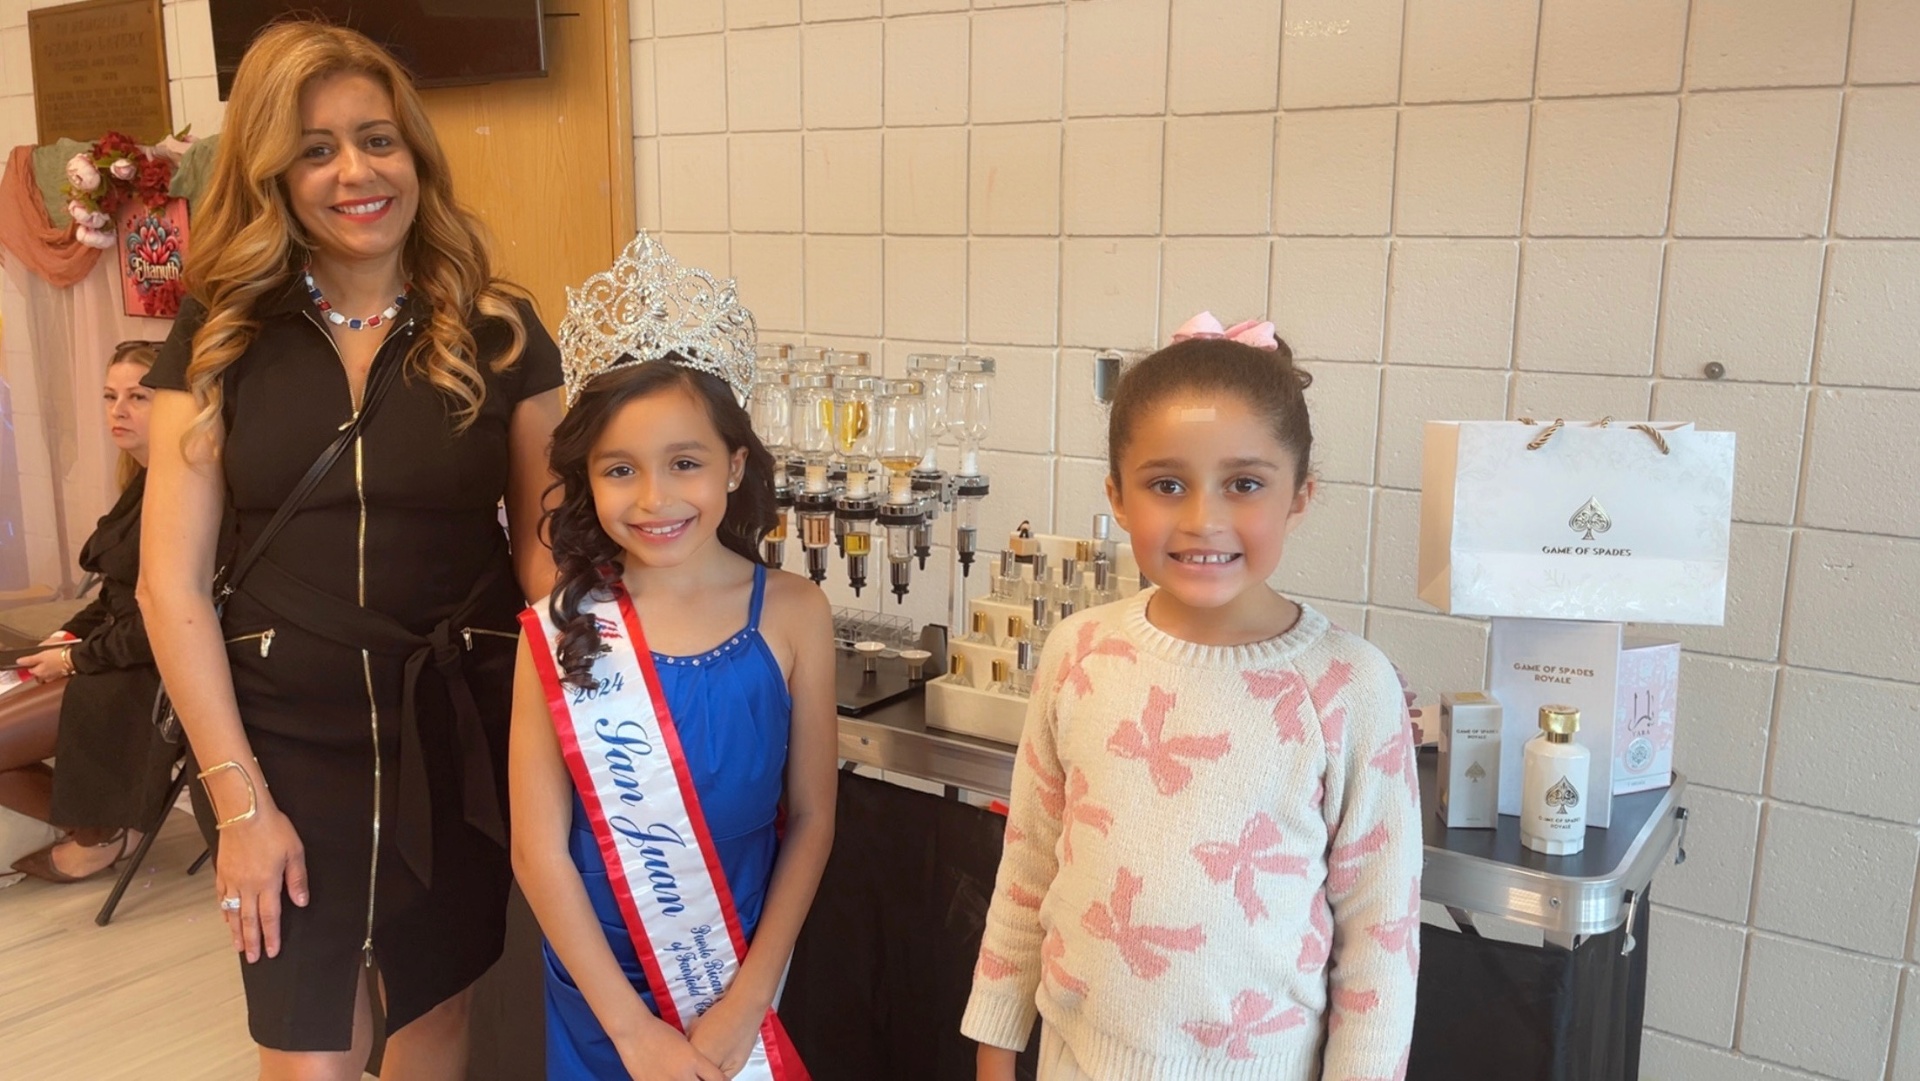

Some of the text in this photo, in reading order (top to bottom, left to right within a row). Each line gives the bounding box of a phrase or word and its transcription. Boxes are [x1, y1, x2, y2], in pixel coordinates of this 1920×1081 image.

[1542, 546, 1632, 556] GAME OF SPADES
[1513, 662, 1595, 677] GAME OF SPADES
[1535, 674, 1571, 684] ROYALE
[573, 672, 624, 706] 2024
[594, 718, 652, 806] San
[609, 815, 686, 917] Juan
[663, 942, 692, 952] of
[690, 925, 725, 995] Puerto Rican
[675, 952, 707, 996] Fairfield
